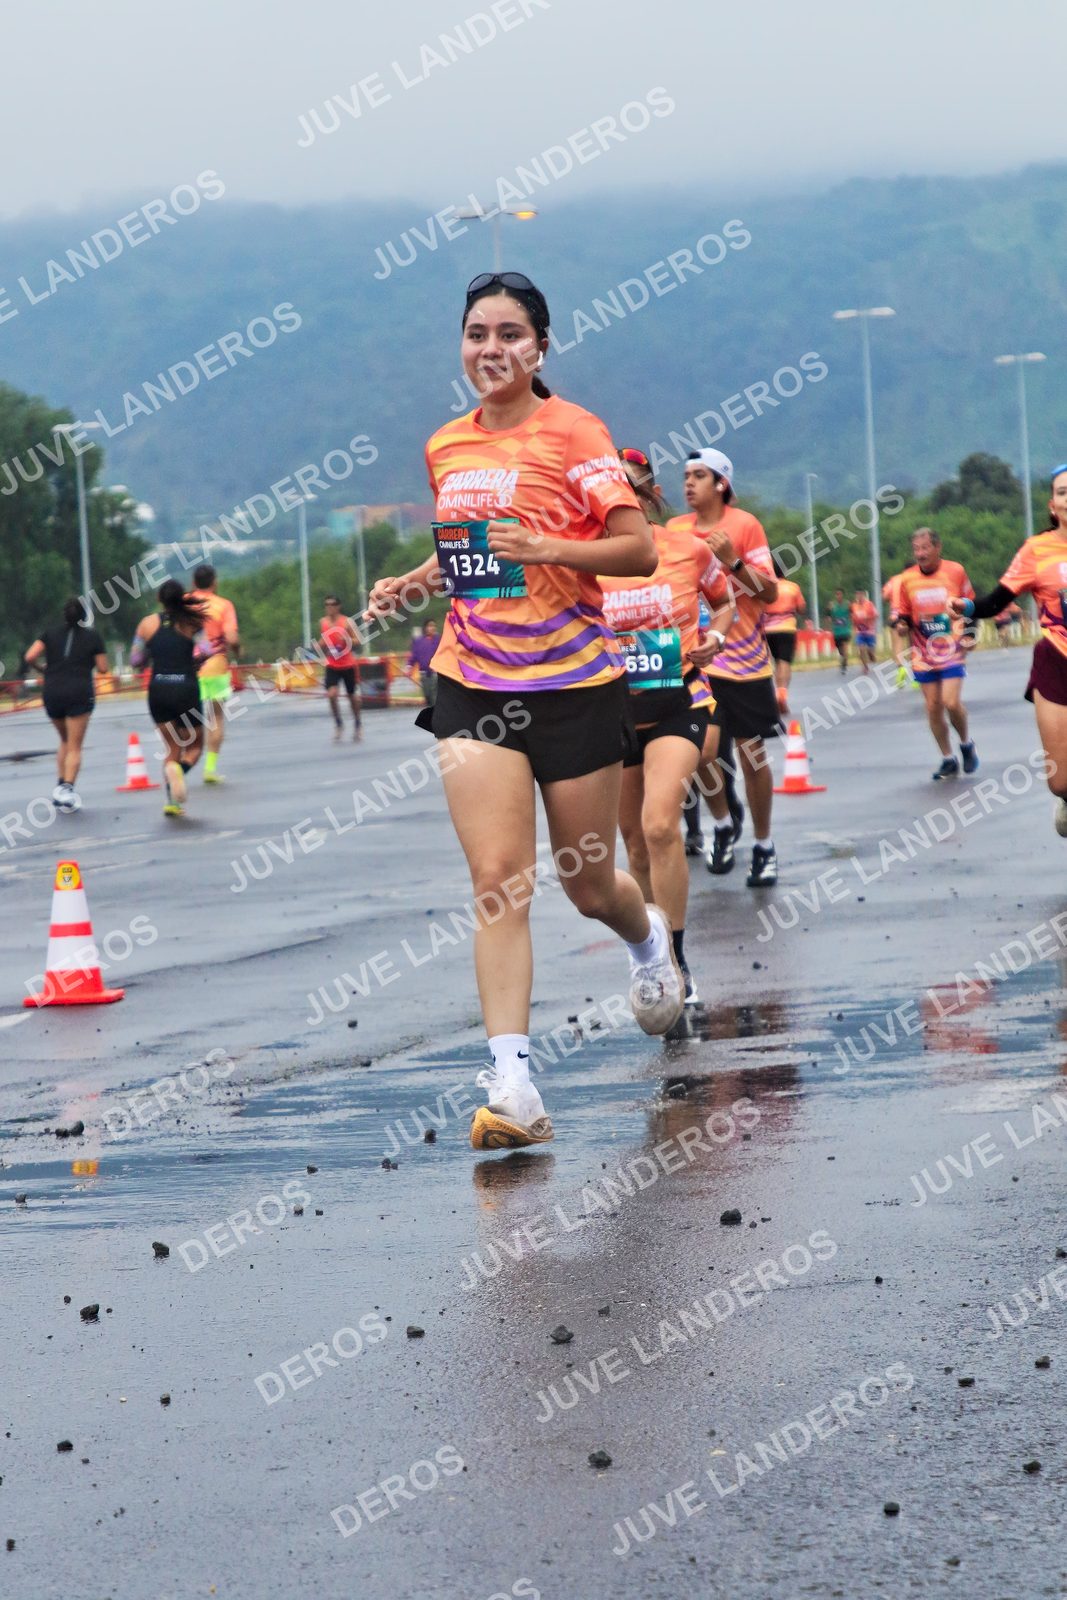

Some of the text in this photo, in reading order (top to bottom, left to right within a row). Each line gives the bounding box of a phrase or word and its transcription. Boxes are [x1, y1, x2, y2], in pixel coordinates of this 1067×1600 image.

[438, 468, 519, 492] CARRERA
[438, 492, 494, 510] OMNILIFE
[438, 528, 469, 541] CARRERA
[439, 540, 462, 550] OMNILIFE
[449, 553, 500, 576] 1324
[625, 653, 663, 673] 630
